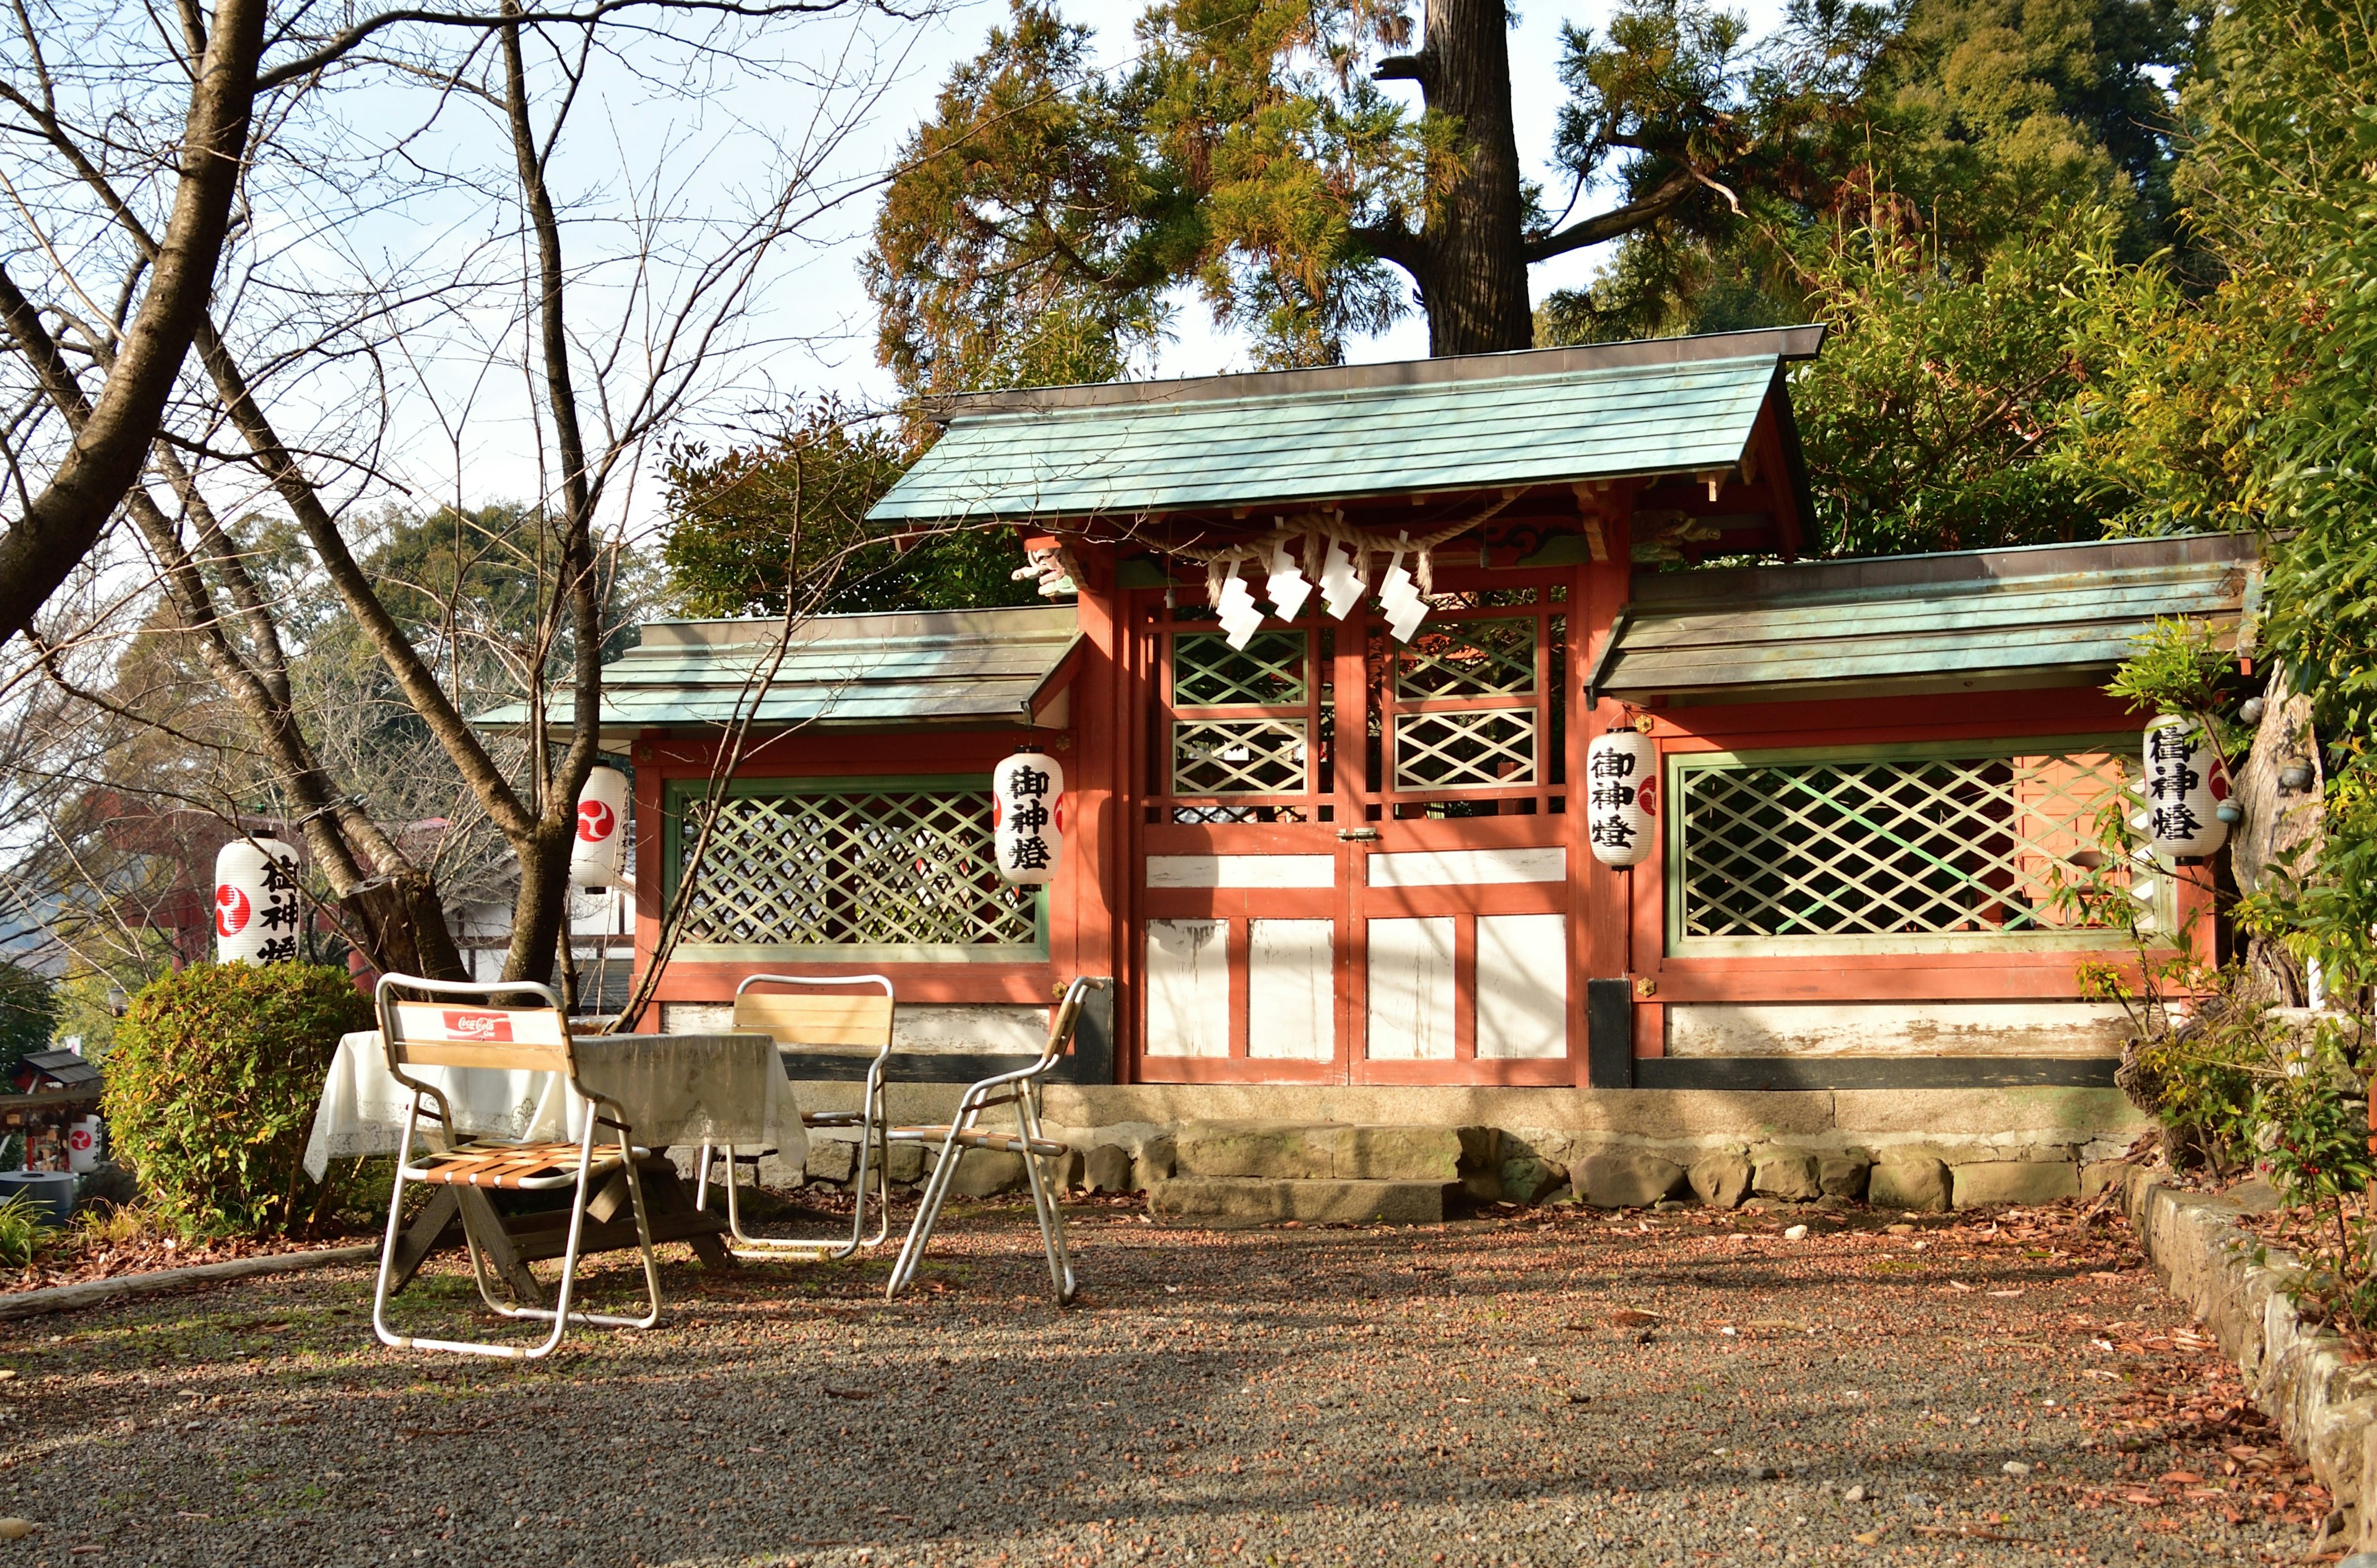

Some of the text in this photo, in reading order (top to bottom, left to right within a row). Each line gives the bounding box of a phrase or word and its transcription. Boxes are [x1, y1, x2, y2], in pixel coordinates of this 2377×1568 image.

[1007, 765, 1052, 870] 御神燈
[1590, 747, 1637, 849] 御神燈
[2149, 726, 2204, 840] 御神燈
